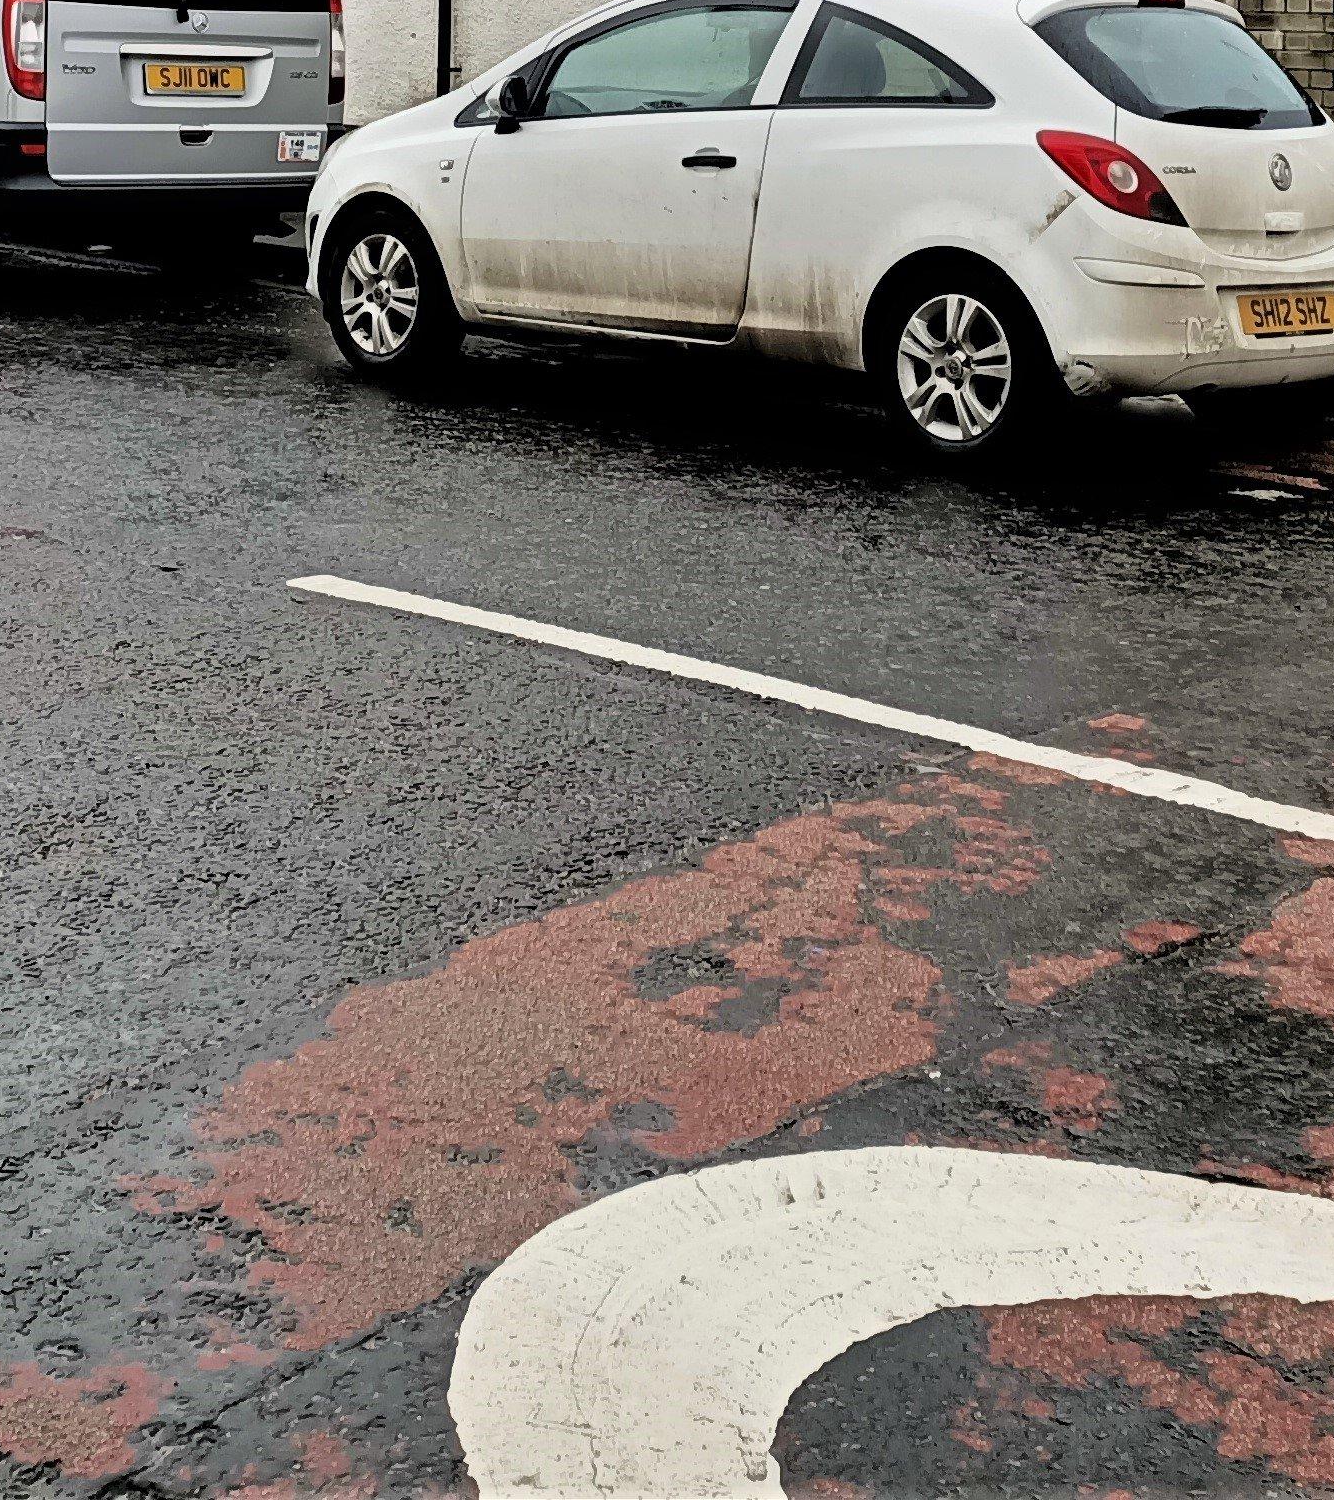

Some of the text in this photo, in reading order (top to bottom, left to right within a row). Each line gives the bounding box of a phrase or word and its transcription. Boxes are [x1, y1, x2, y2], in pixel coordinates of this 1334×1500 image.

[159, 67, 231, 89] SJ11 OWC
[1250, 296, 1331, 328] SH12 SHZ
